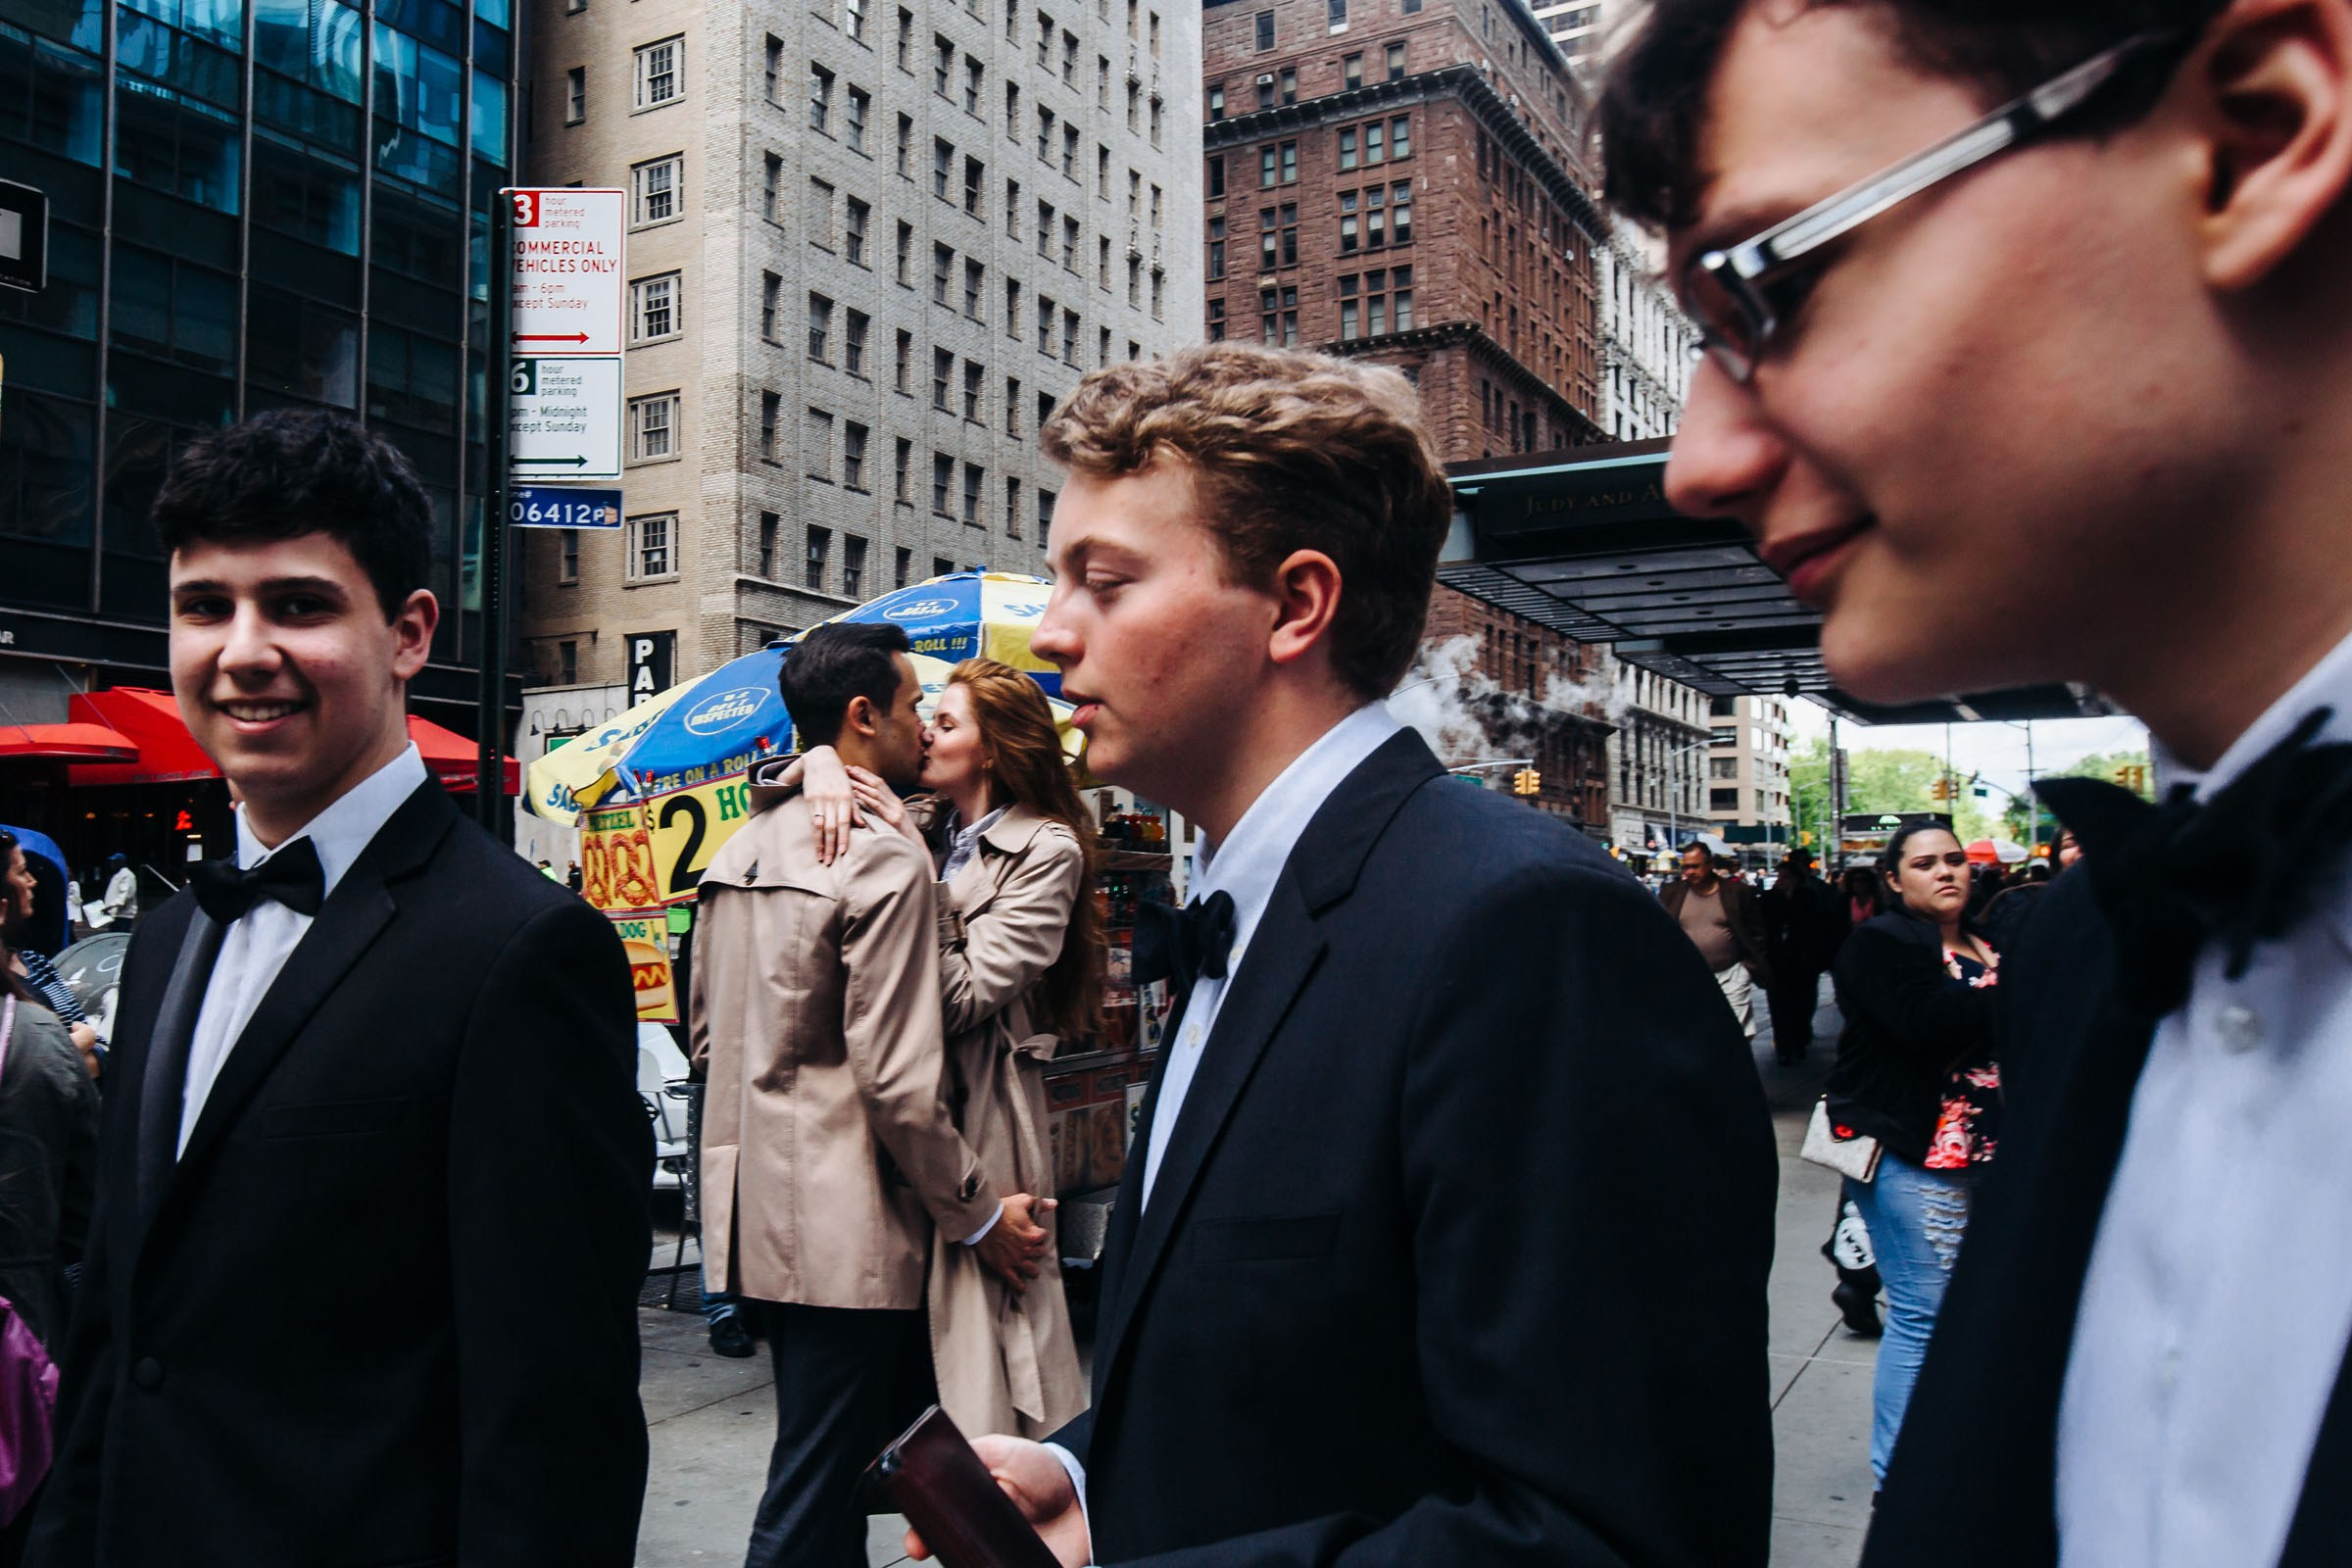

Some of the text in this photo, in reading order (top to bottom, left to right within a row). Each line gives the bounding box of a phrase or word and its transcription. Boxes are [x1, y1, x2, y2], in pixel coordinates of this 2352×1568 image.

[545, 196, 566, 206] hour
[513, 194, 533, 225] 3
[545, 207, 585, 218] metered
[545, 220, 581, 230] parking
[514, 241, 605, 255] OMMERCIAL
[581, 259, 617, 272] ONLY
[540, 282, 565, 296] 6pm
[512, 297, 588, 312] xcept Sunday
[541, 366, 564, 374] hour
[512, 362, 529, 393] 6
[541, 376, 582, 386] metered
[541, 387, 578, 398] parking
[540, 406, 588, 420] Midnight
[511, 420, 588, 435] xcept Sunday
[1585, 490, 1634, 509] AND
[914, 638, 947, 654] ROLL
[685, 766, 705, 784] ON
[710, 762, 719, 777] A
